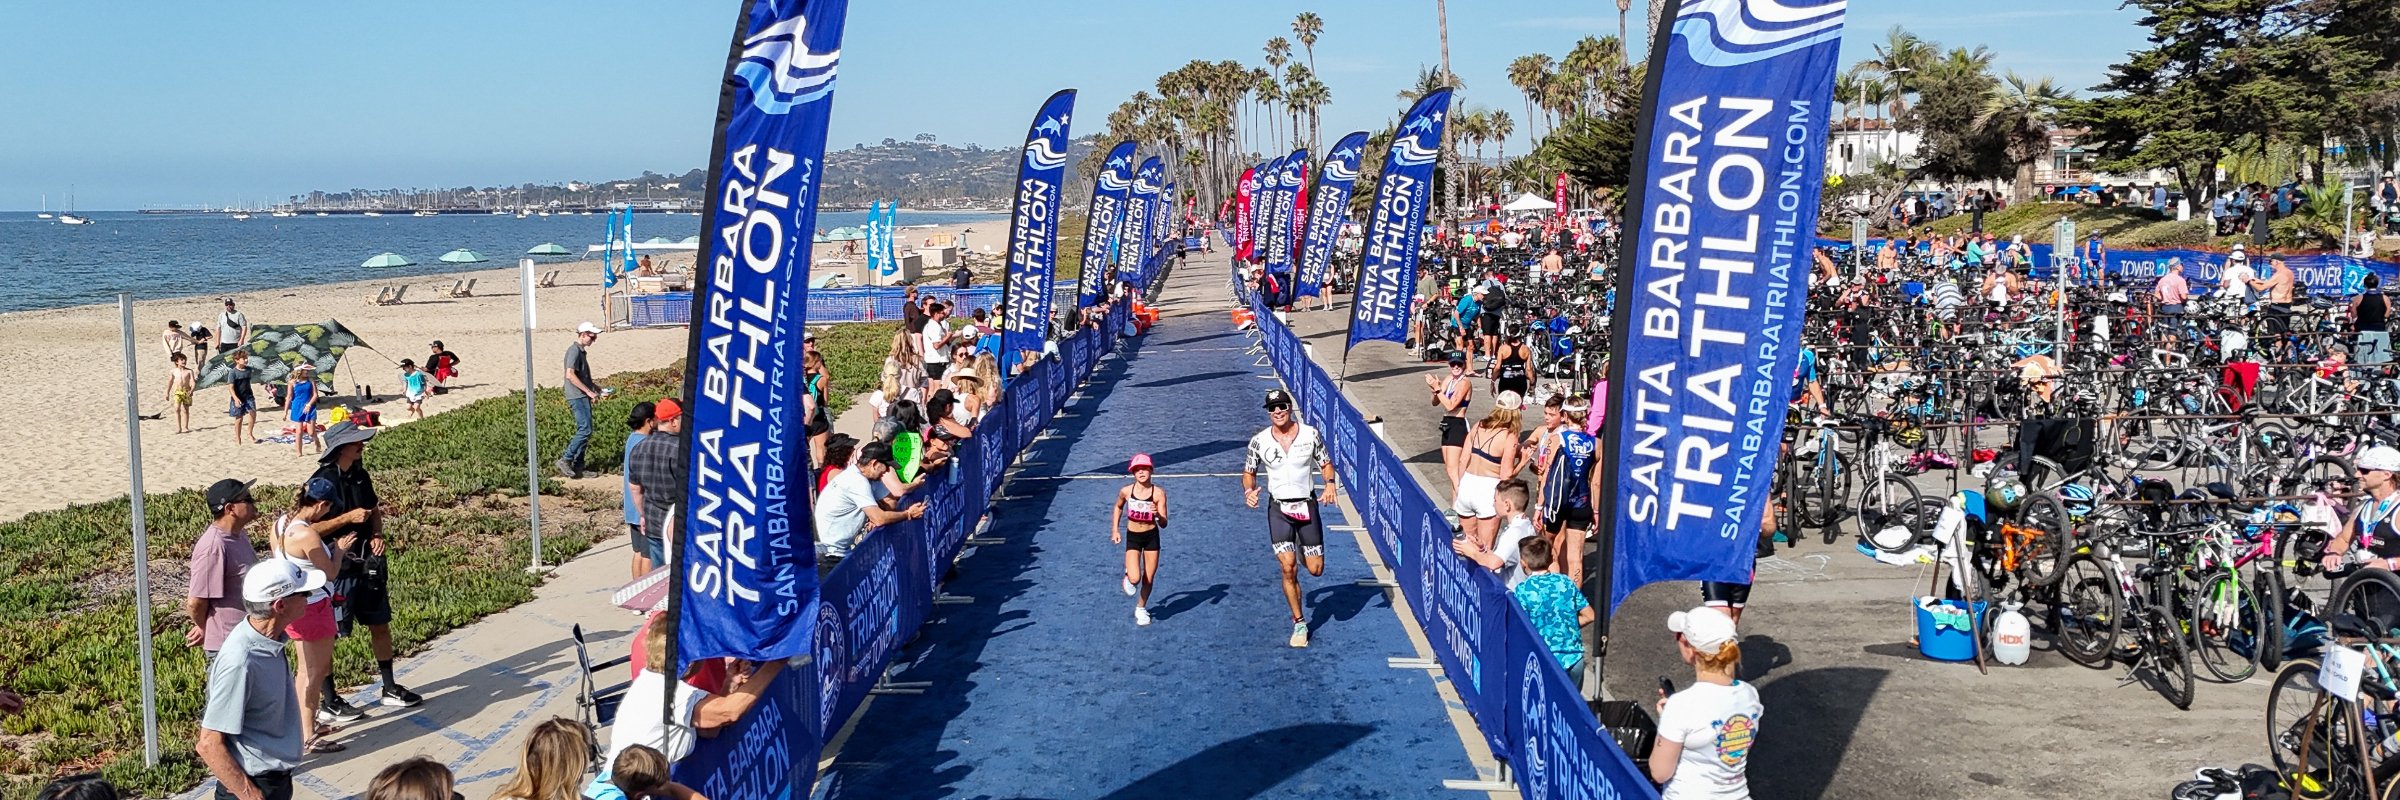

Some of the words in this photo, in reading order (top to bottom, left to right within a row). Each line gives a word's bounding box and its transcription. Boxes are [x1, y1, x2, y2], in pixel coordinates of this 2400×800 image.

[869, 220, 881, 259] HOKA
[1013, 178, 1034, 264] BARBARA
[1086, 196, 1116, 297] TRIATHLON
[1087, 195, 1104, 252] BARBARA
[1124, 198, 1136, 241] BARBARA
[1125, 198, 1145, 273] TRIATHLON
[1259, 190, 1273, 251] TRIATHLON
[1269, 235, 1277, 264] SANTA
[1272, 190, 1284, 231] BARBARA
[1274, 191, 1293, 265] TRIATHLON
[1301, 242, 1315, 283] SANTA
[1310, 185, 1329, 240] BARBARA
[1308, 186, 1342, 285] TRIATHLON
[1358, 264, 1379, 322] SANTA
[1369, 173, 1397, 259] BARBARA
[1374, 174, 1415, 325] TRIATHLON
[1643, 95, 1708, 339] BARBARA
[704, 144, 757, 405] BARBARA
[1018, 180, 1049, 334] TRIATHLON
[1081, 256, 1094, 296] SANTA
[1119, 243, 1131, 272] SANTA
[1396, 180, 1425, 329] SANTABARBARATRIATHLON.COM
[2120, 259, 2155, 277] TOWER
[2297, 265, 2342, 287] TOWER
[1005, 272, 1023, 332] SANTA
[1666, 97, 1773, 531] TRIATHLON
[1721, 100, 1810, 541] SANTABARBARATRIATHLON.COM
[726, 147, 795, 607] TRIATHLON
[765, 157, 814, 618] SANTABARBARATRIATHLON.COM
[1629, 362, 1676, 526] SANTA
[689, 429, 724, 600] SANTA
[1437, 537, 1454, 575] SANTA
[847, 575, 873, 619] SANTA
[848, 566, 898, 656] TRIATHLON
[1437, 561, 1482, 653] TRIATHLON
[1998, 633, 2024, 645] HDX
[727, 697, 783, 786] BARBARA
[1551, 701, 1578, 768] SANTA
